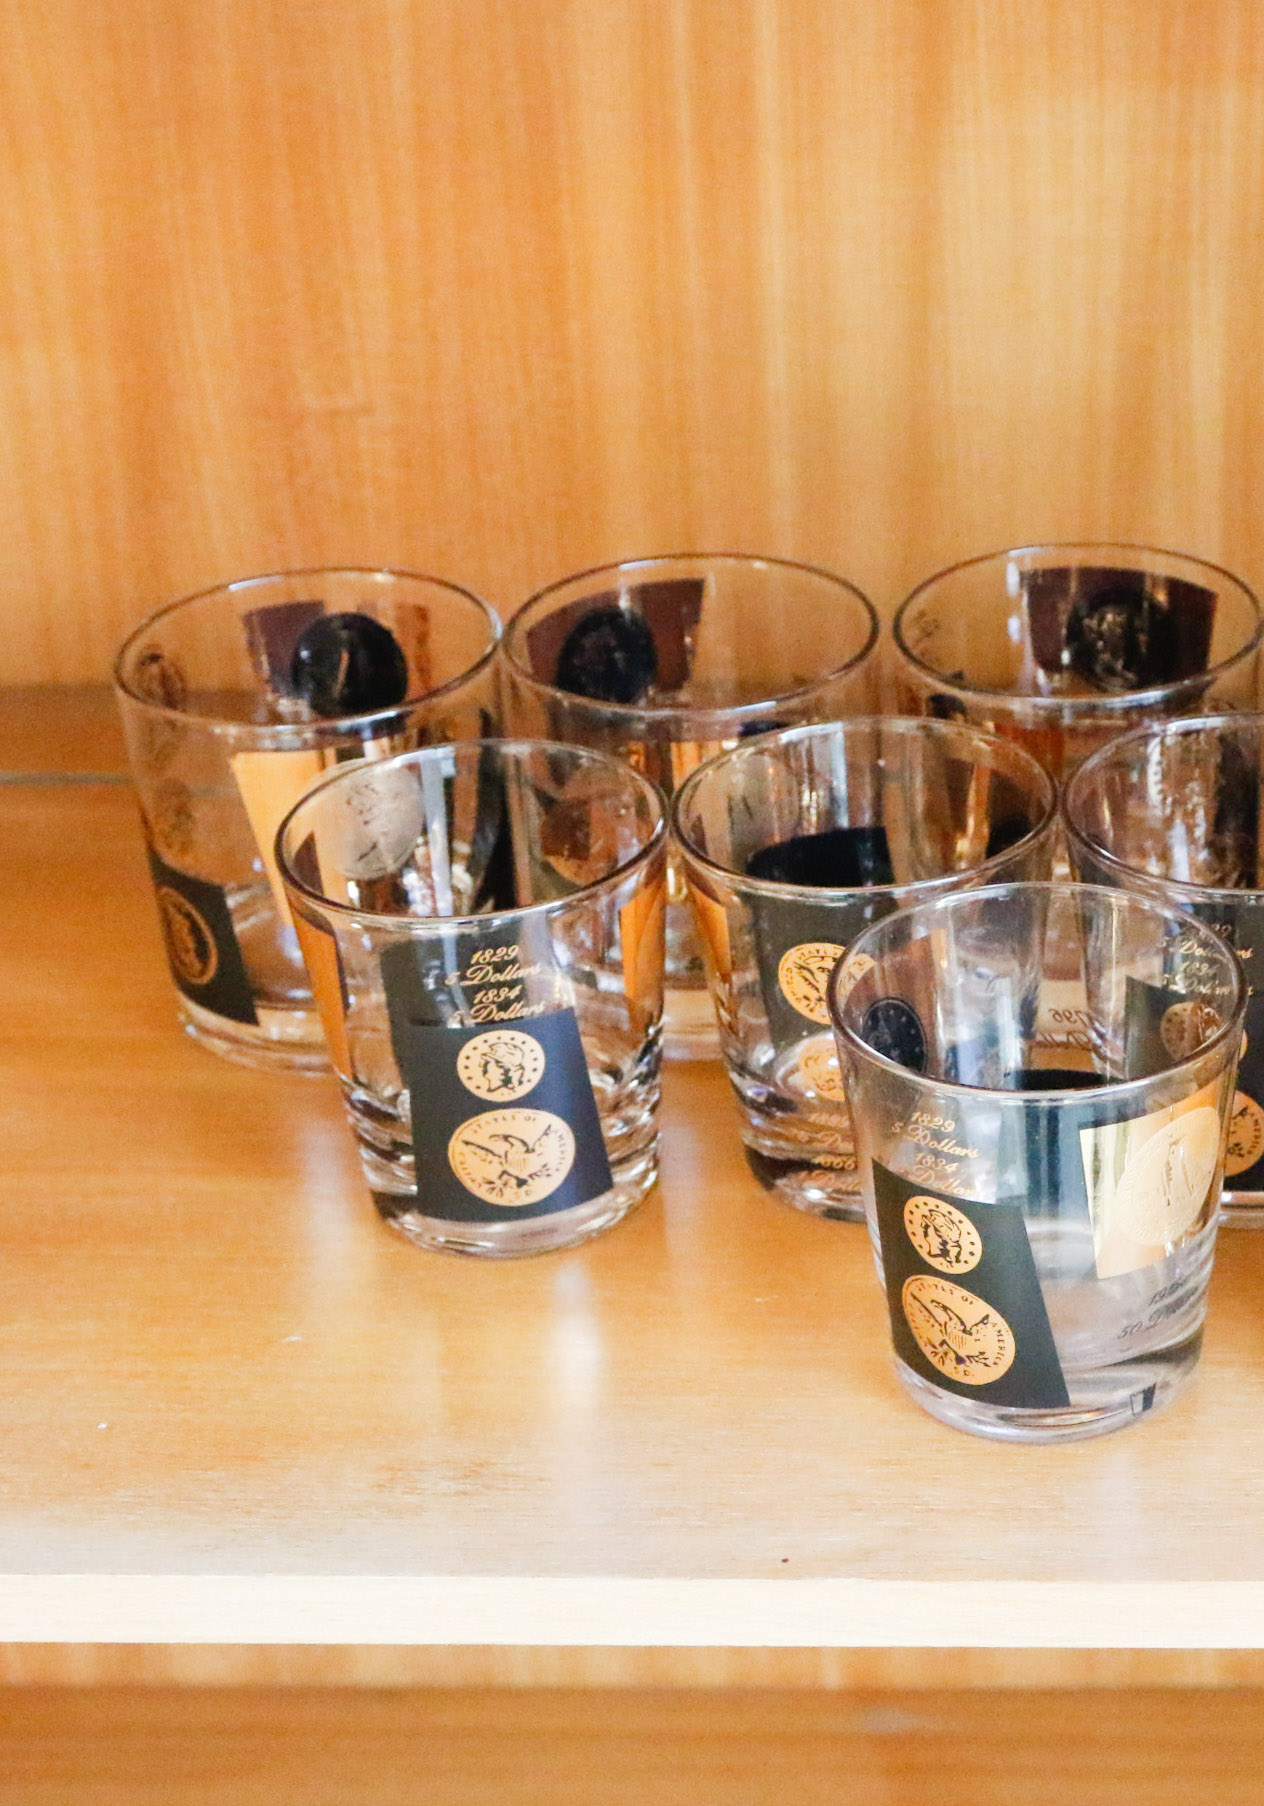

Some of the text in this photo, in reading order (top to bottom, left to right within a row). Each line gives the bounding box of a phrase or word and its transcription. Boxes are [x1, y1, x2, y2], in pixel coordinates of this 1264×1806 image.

[471, 945, 520, 964] 1829
[460, 963, 542, 986] Dollars
[473, 985, 523, 1004] 1834
[464, 1001, 546, 1024] Dollars
[911, 1112, 956, 1132] 1829
[891, 1121, 980, 1158] 5 Dollars
[915, 1152, 960, 1174] 1834
